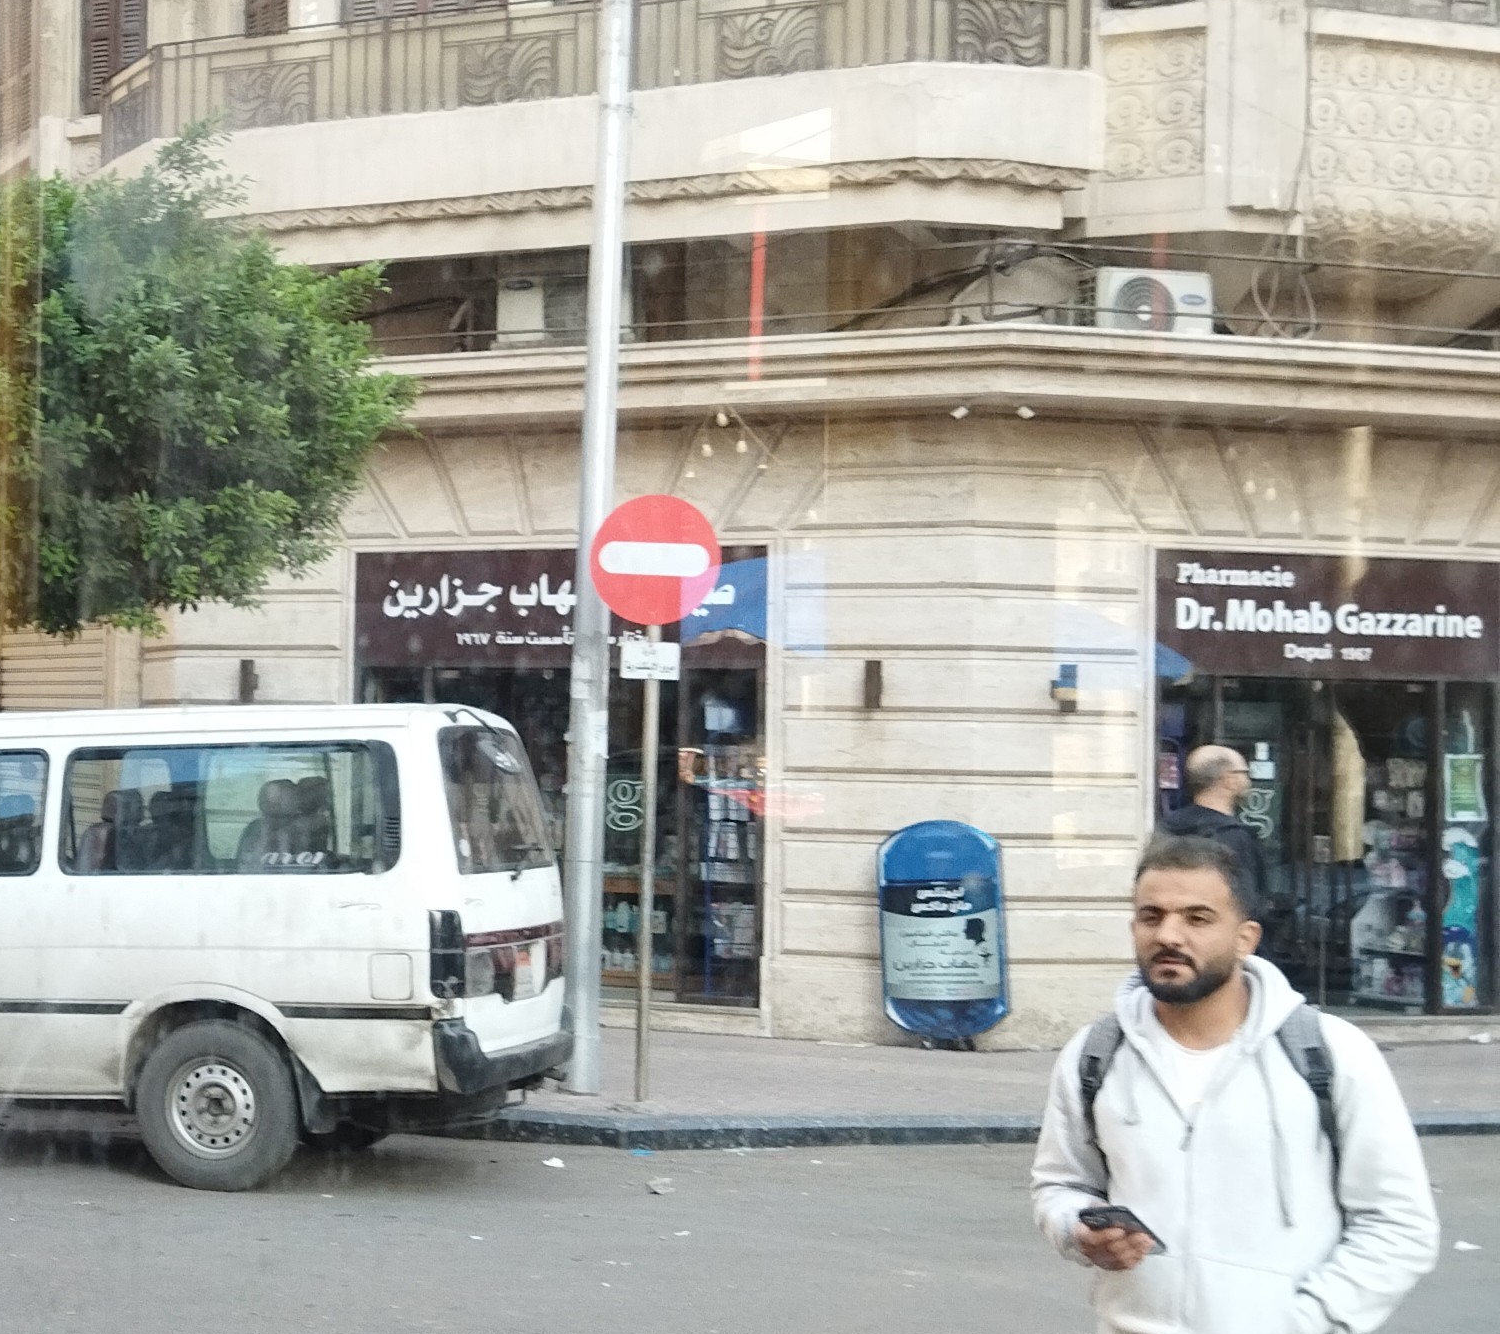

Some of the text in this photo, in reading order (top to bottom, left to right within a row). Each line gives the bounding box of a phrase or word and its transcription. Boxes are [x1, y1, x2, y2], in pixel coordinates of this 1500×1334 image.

[1175, 561, 1296, 588] Pharmacie
[382, 572, 577, 619] هاب جزارين
[1175, 597, 1484, 639] Dr. Mohab Gazzarine
[495, 630, 525, 646] سنة
